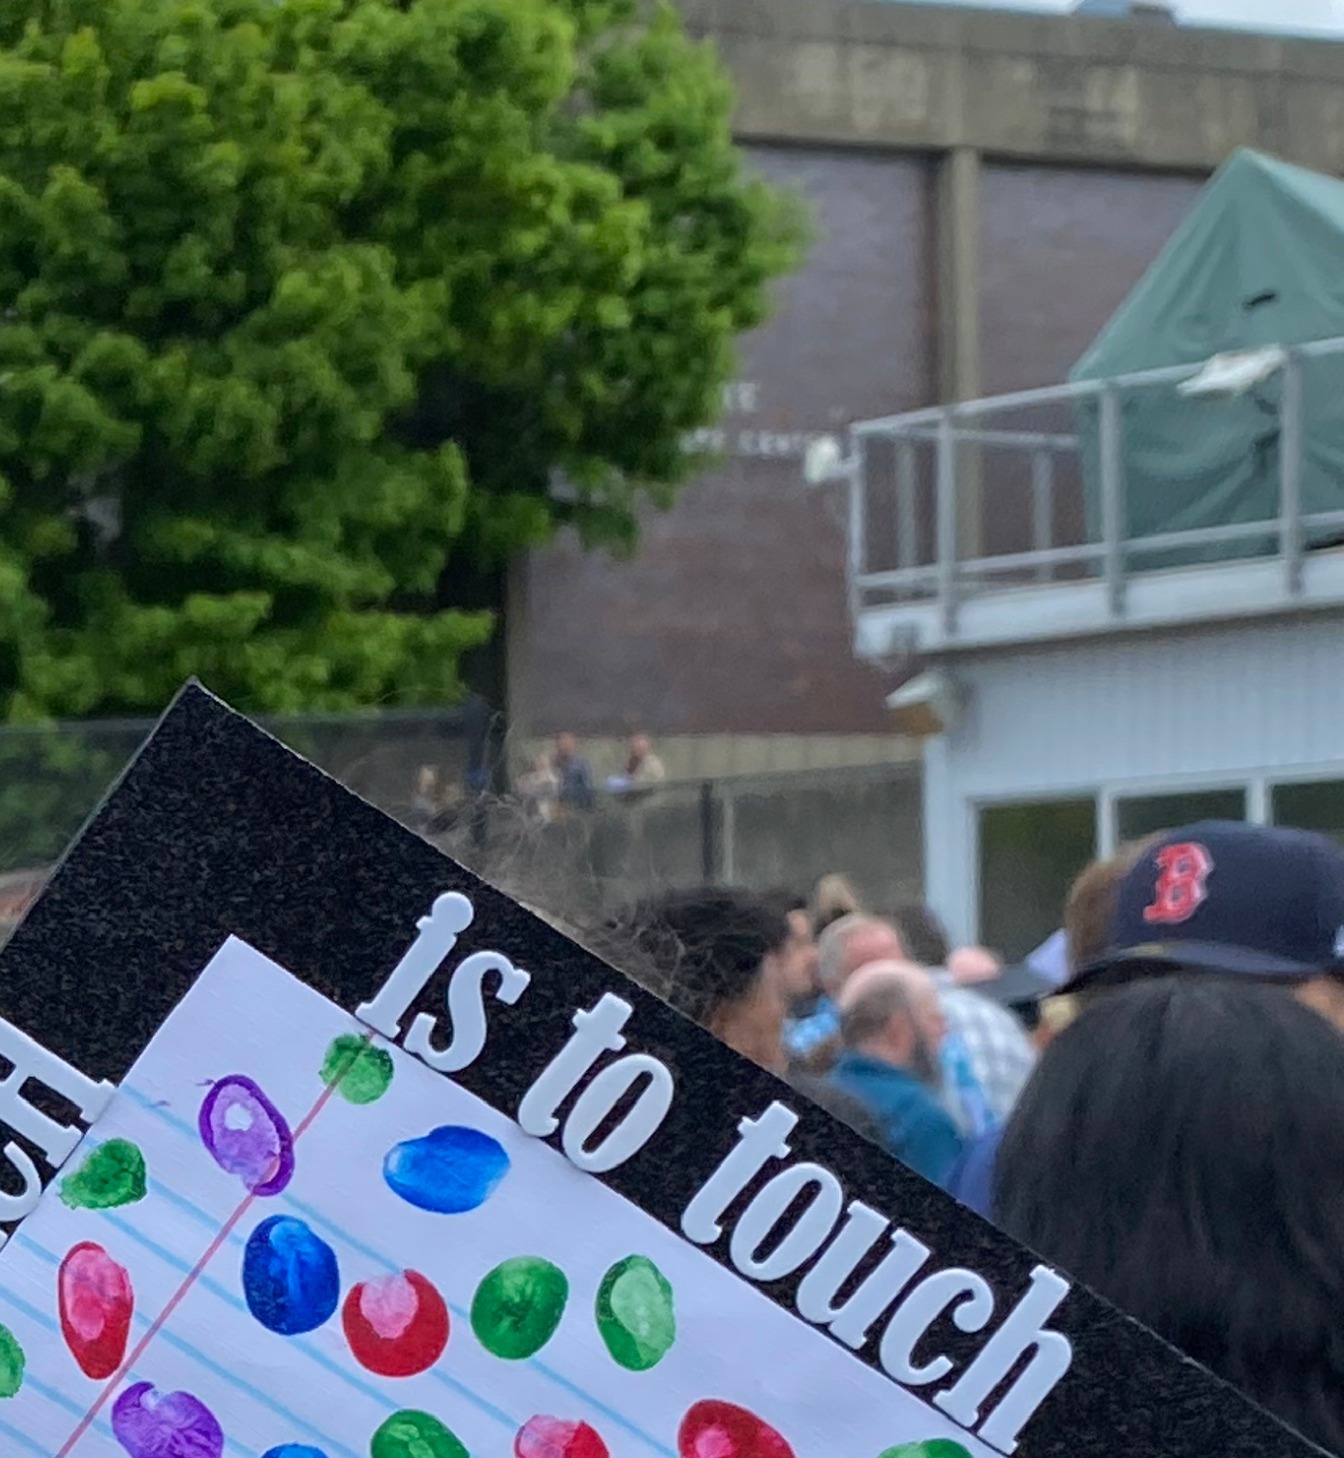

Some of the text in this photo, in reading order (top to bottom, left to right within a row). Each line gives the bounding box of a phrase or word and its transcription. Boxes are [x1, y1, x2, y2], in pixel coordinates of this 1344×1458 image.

[1143, 842, 1214, 924] B
[355, 891, 1074, 1455] is to touch
